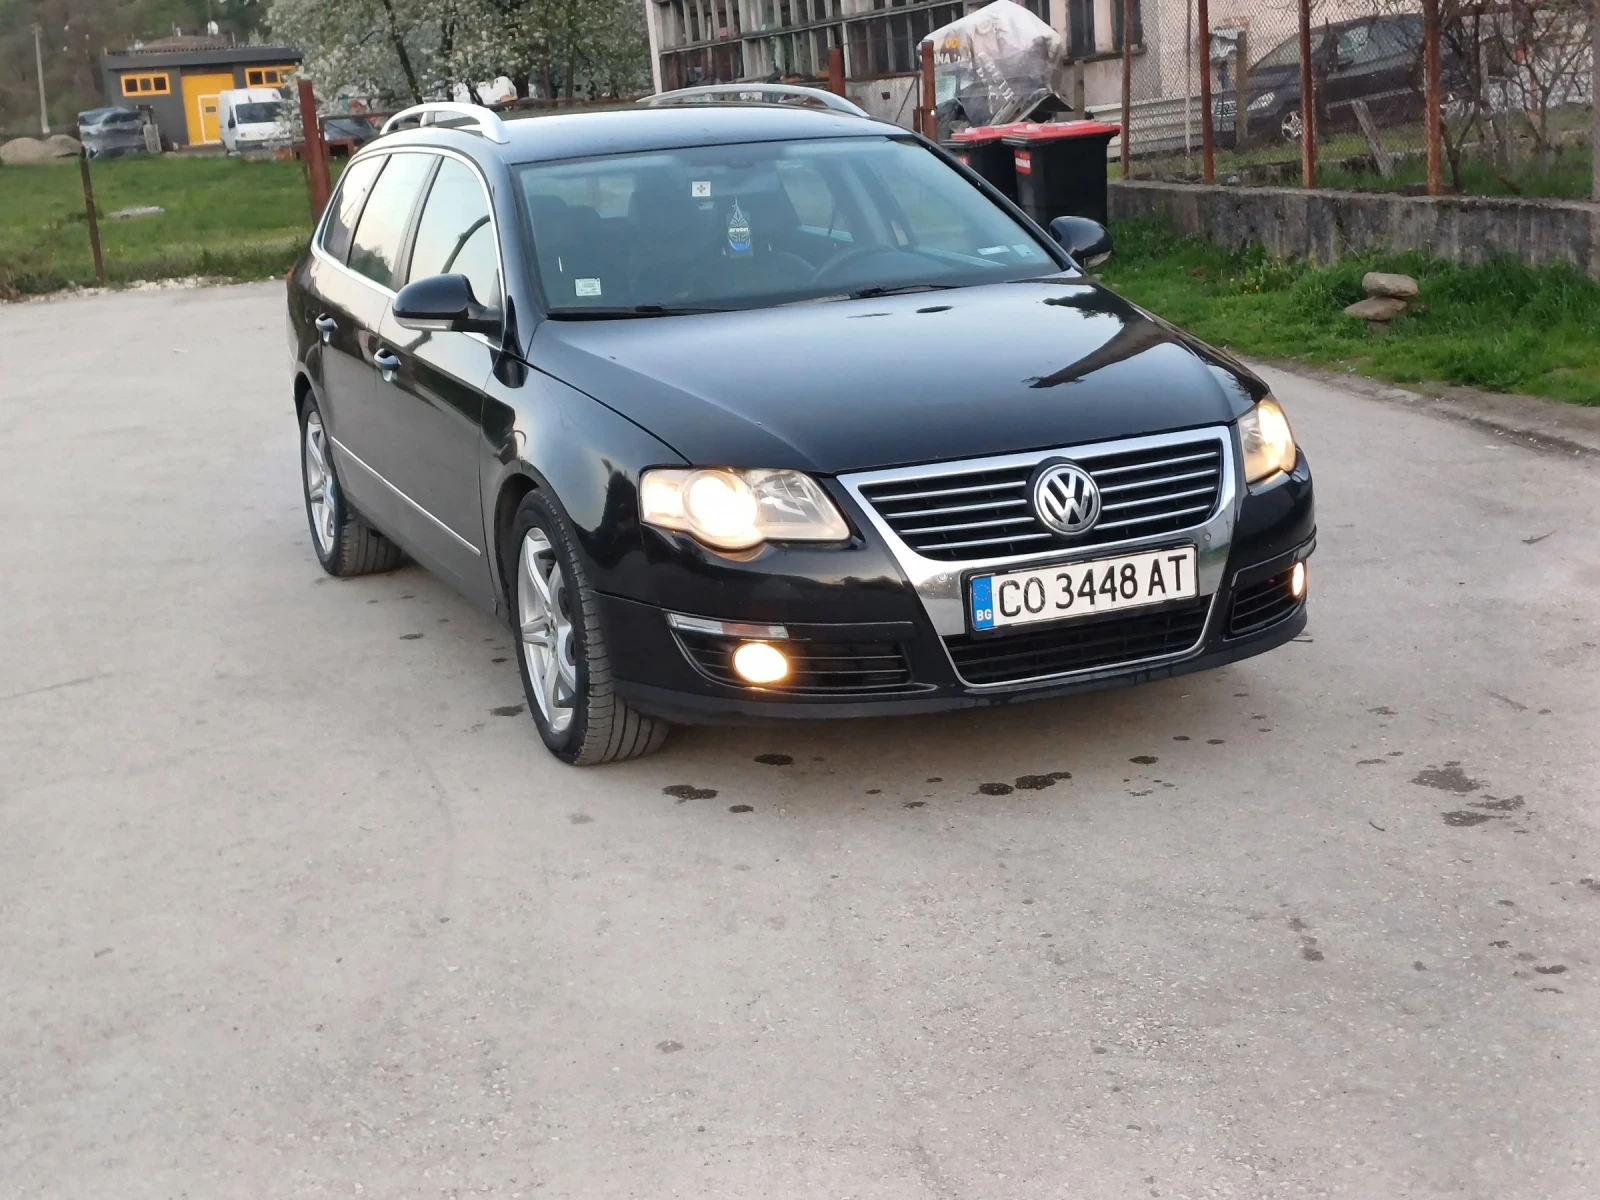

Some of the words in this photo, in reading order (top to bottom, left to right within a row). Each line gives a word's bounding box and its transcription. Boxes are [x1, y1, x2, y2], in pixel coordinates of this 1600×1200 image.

[999, 576, 1046, 618] CO
[1055, 562, 1138, 609] 3448
[1147, 553, 1188, 597] AT
[976, 608, 992, 622] BG
